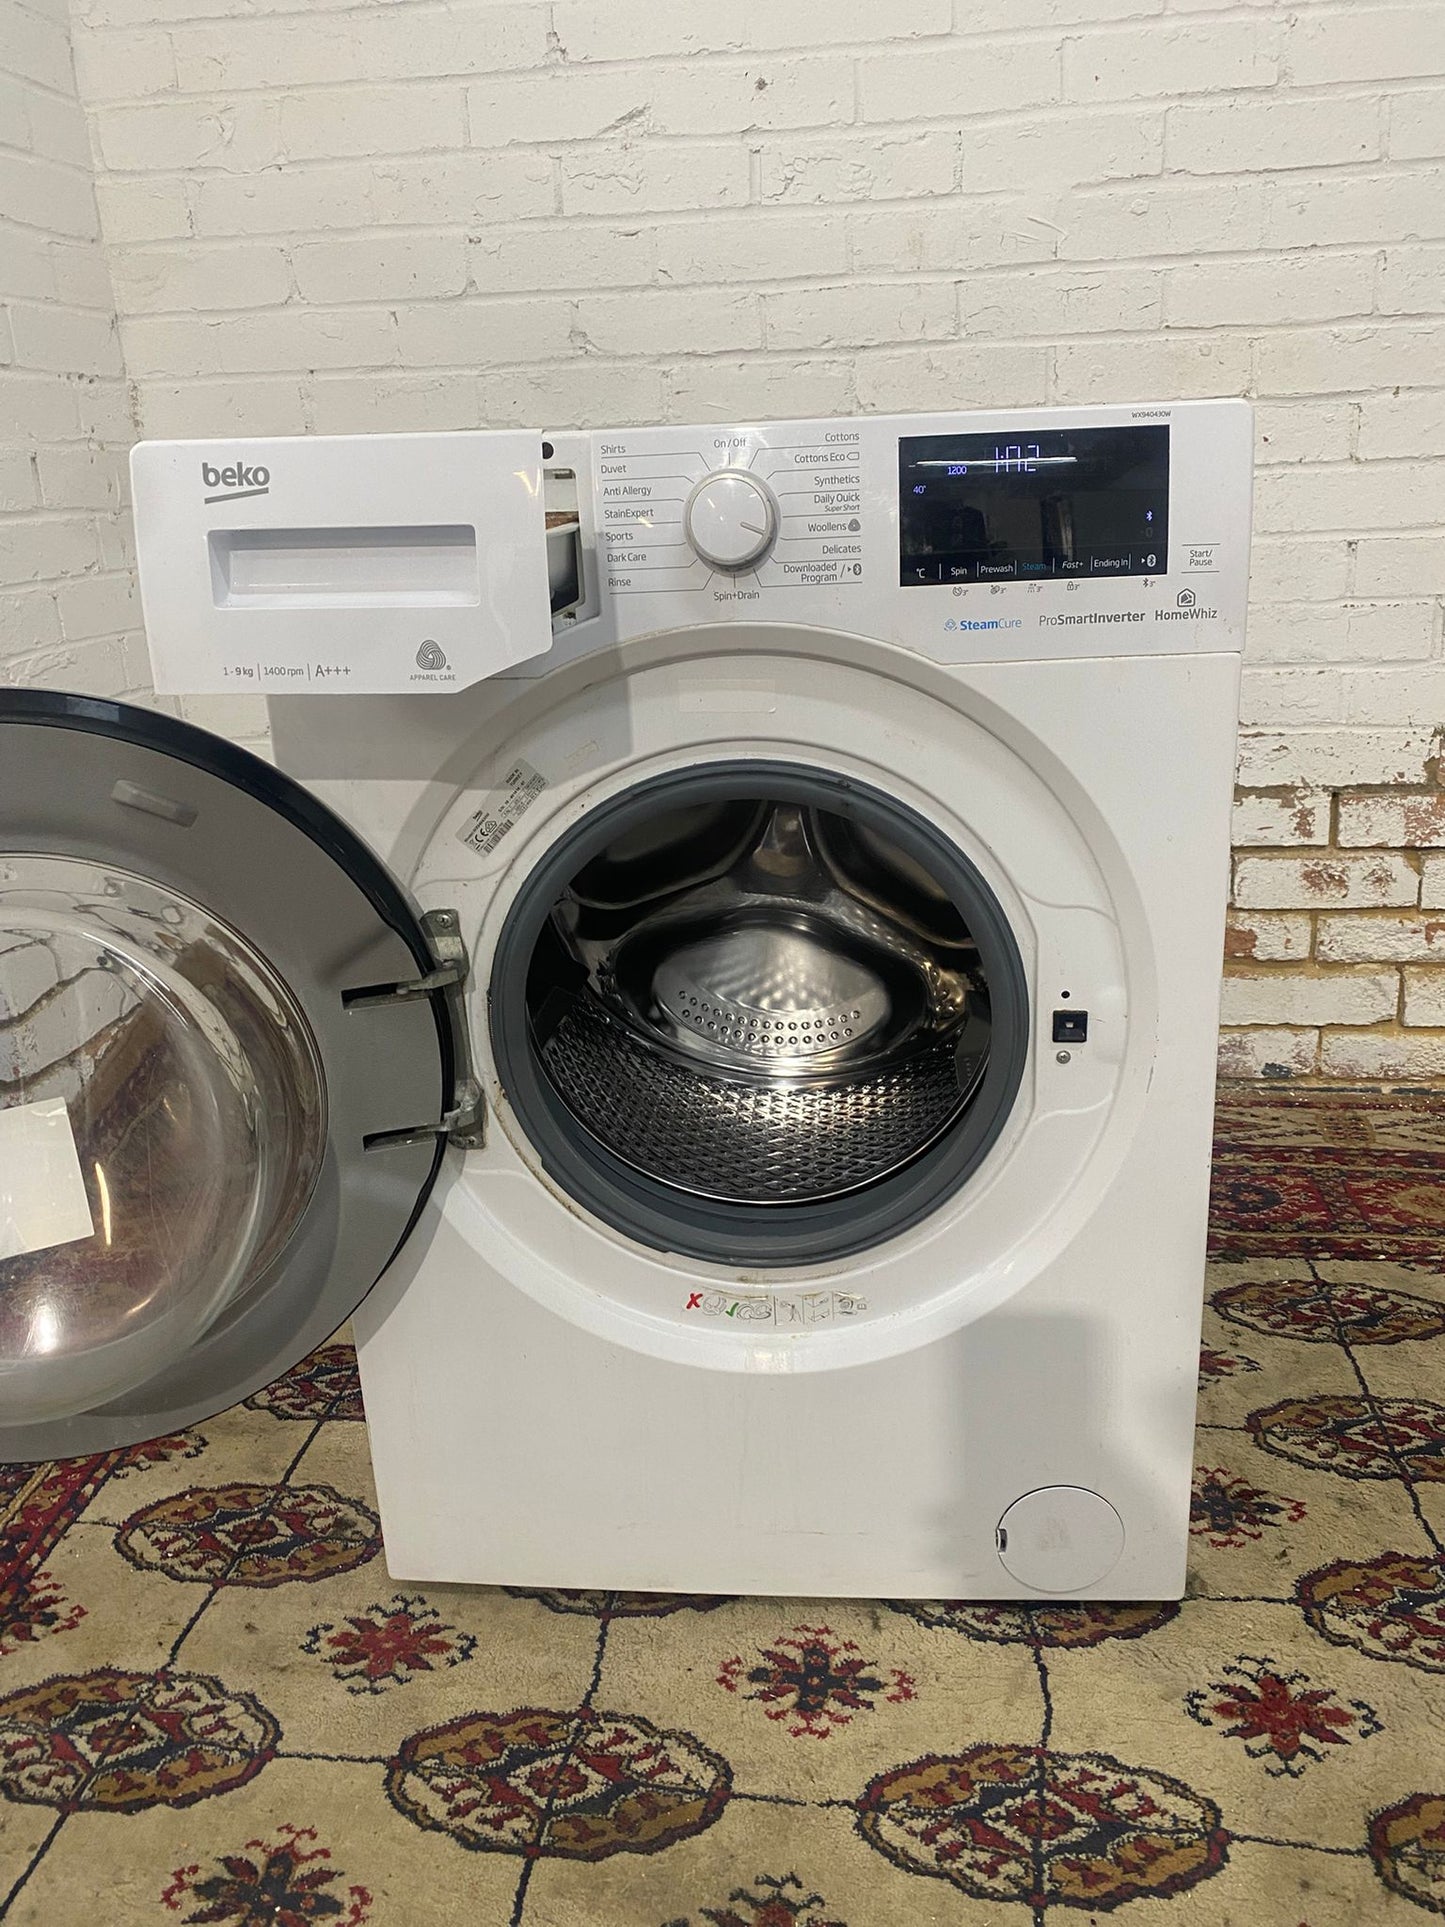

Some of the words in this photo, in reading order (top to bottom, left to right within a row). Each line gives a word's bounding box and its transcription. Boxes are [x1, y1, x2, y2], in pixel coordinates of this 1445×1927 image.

[825, 433, 860, 442] Cottons
[600, 444, 626, 454] Shirts
[794, 454, 829, 463] Cottons
[830, 452, 846, 462] Eco
[202, 461, 270, 488] beko
[600, 465, 627, 474] Duvet
[947, 465, 968, 476] 1200
[814, 475, 860, 487] Synthetics
[603, 487, 621, 497] Anti
[622, 486, 652, 497] Allergy
[813, 494, 836, 505] Daily
[836, 492, 861, 503] Quick
[824, 505, 842, 513] Super
[843, 504, 860, 512] Short
[604, 509, 654, 519] StainExpert
[807, 522, 847, 532] Woollens
[605, 532, 634, 542] Sports
[822, 545, 862, 555] Delicates
[1189, 550, 1213, 558] Start/
[607, 553, 627, 563] Dark
[628, 552, 647, 562] Care
[1189, 558, 1213, 567] Pause
[783, 562, 838, 574] Downloaded
[980, 564, 1014, 573] Prewash
[1022, 562, 1047, 571] Steam
[1062, 560, 1084, 569] Fast+
[1094, 558, 1120, 569] Ending
[1120, 558, 1129, 567] In
[950, 566, 968, 576] Spin
[608, 577, 632, 587] Rinse
[801, 573, 838, 584] Program
[1039, 612, 1146, 626] ProSmartInverter
[1155, 608, 1218, 621] HomeWhiz
[960, 619, 1022, 631] SteamCure
[263, 666, 286, 676] 1400
[287, 668, 304, 677] rpm
[315, 664, 352, 677] A+++
